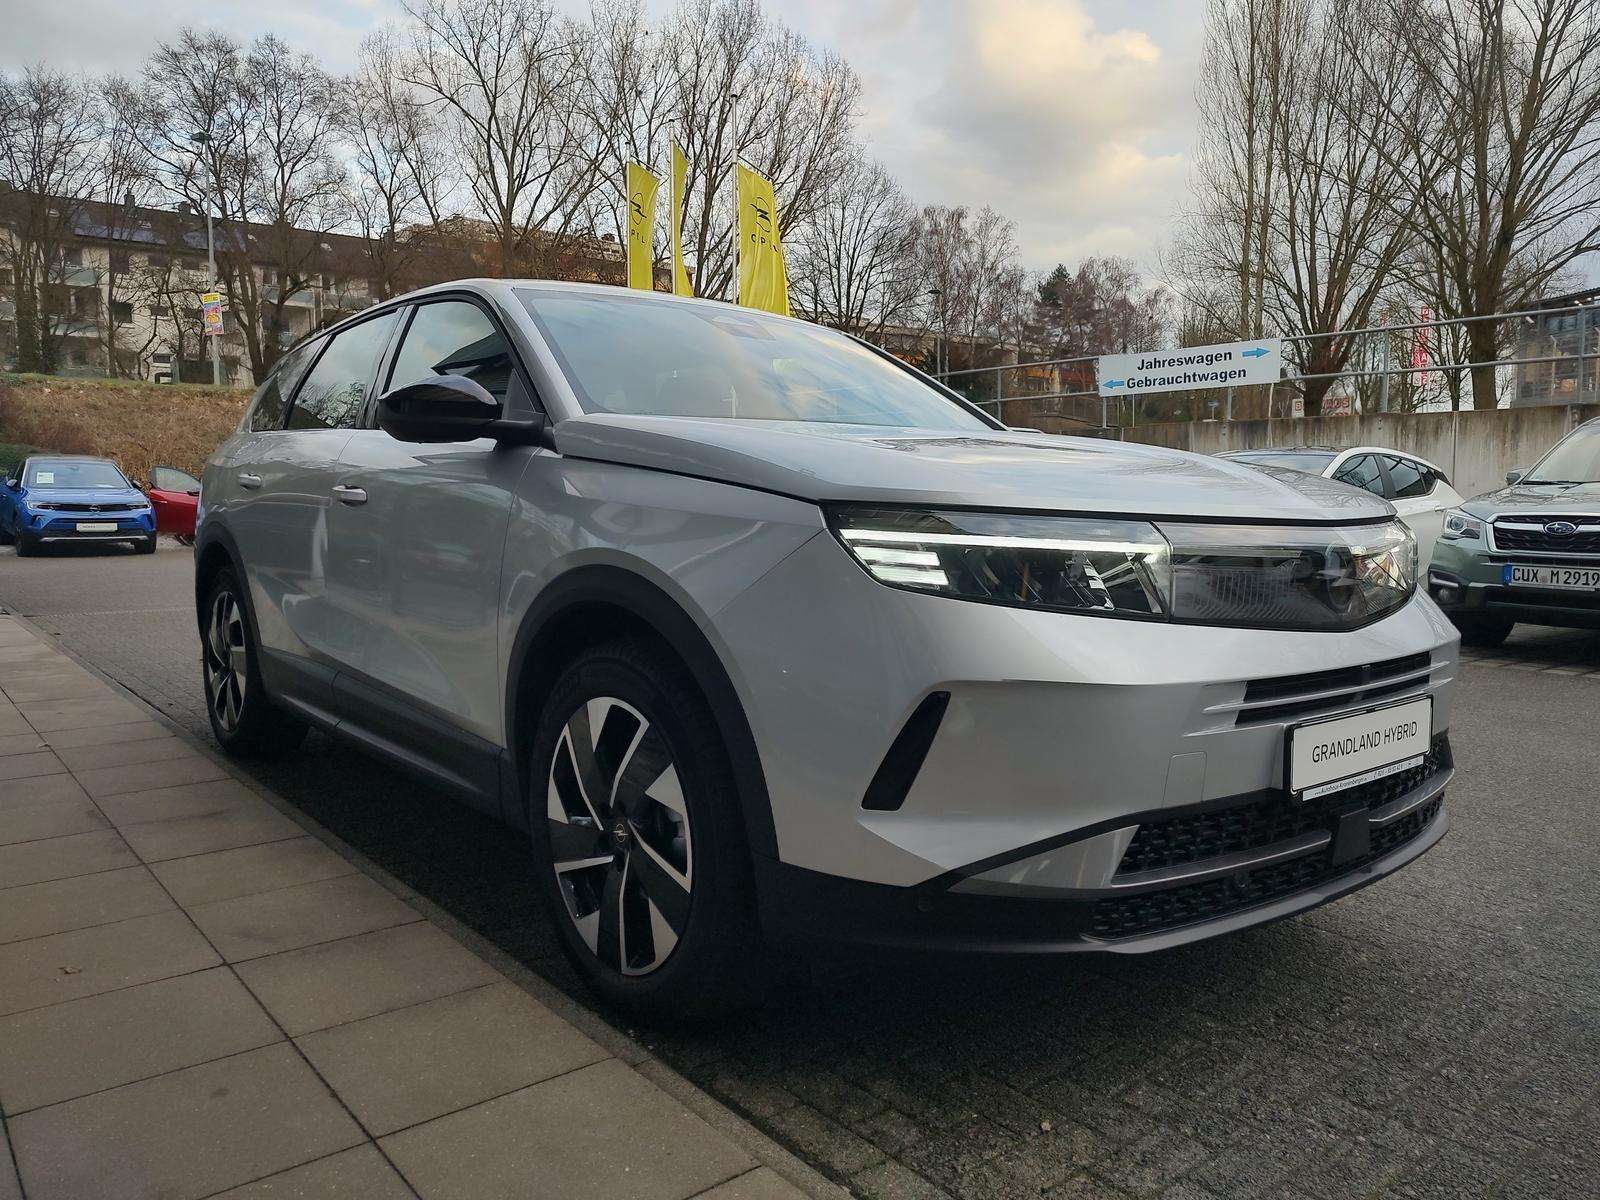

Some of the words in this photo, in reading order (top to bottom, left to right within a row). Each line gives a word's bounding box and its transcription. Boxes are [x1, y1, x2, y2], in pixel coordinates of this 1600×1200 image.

[1137, 351, 1233, 371] Jahreswagen
[1126, 367, 1247, 389] Gebrauchtwagen
[1512, 567, 1540, 583] CUX
[1550, 569, 1560, 584] M
[1563, 570, 1600, 586] 2919
[1312, 731, 1381, 763] GRANDLAND
[1383, 721, 1418, 745] HYBRID
